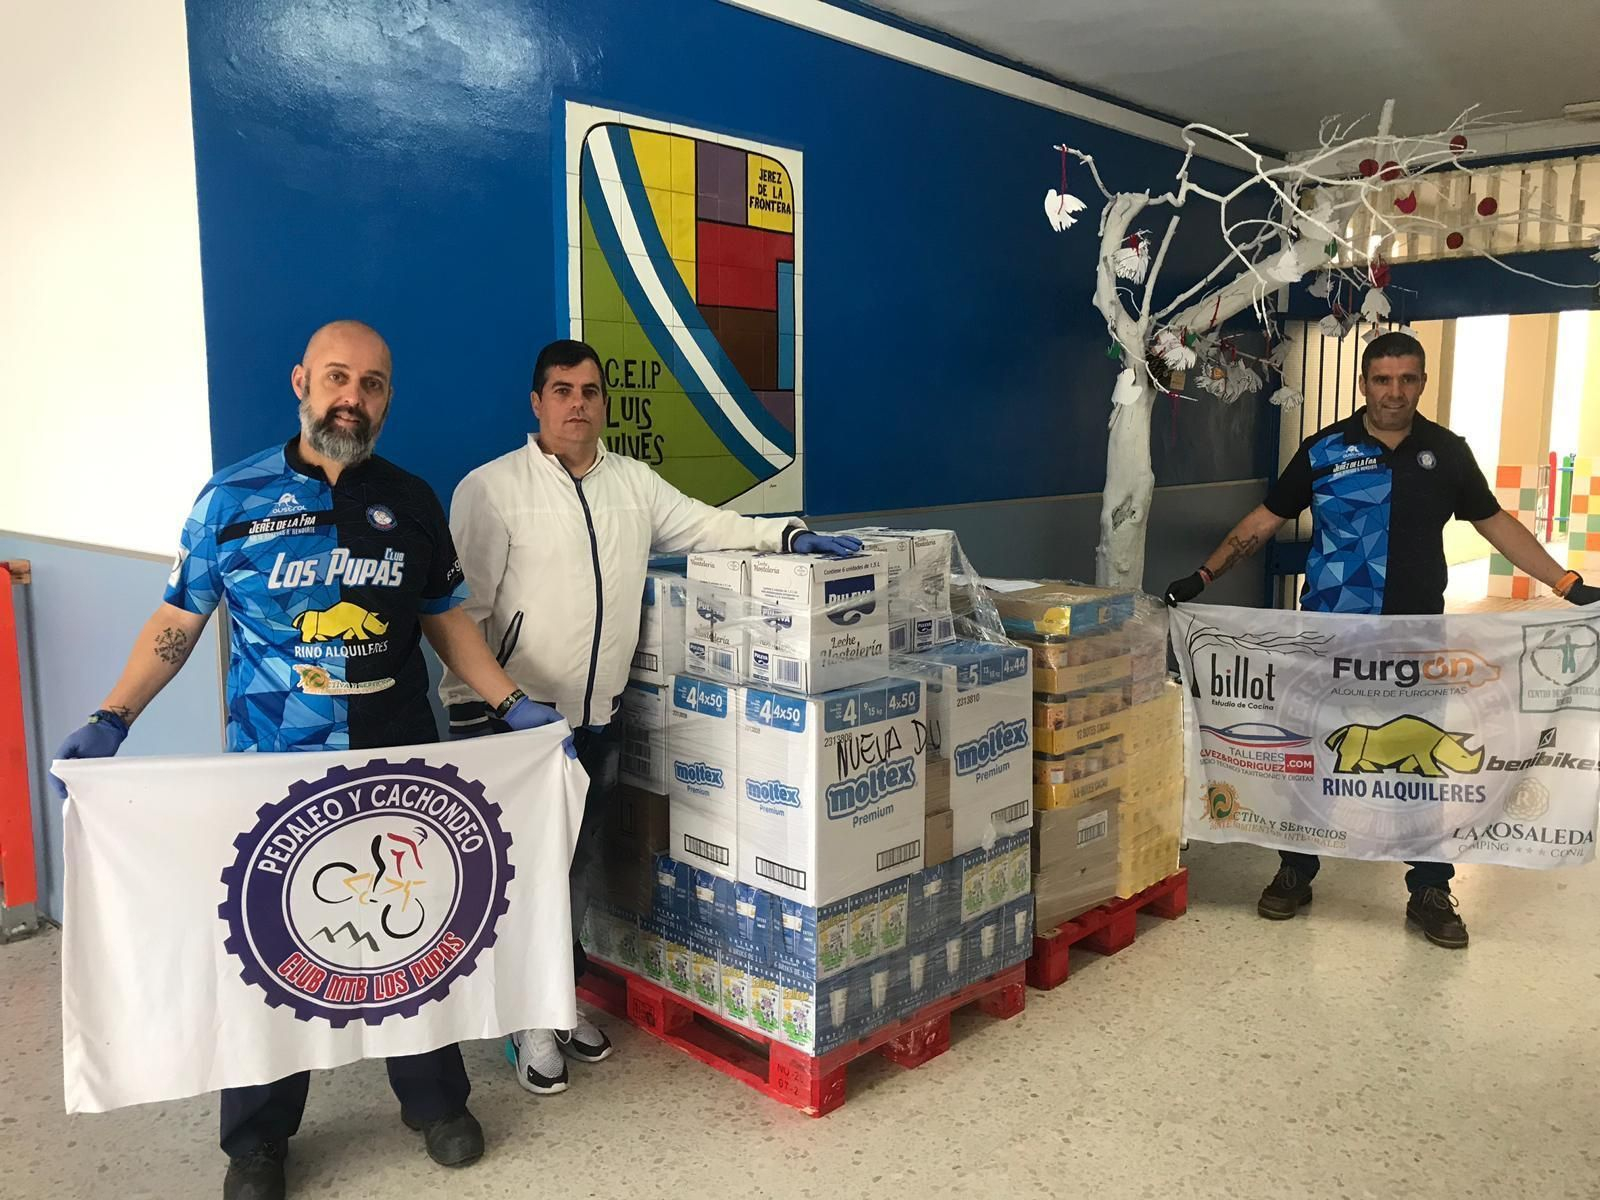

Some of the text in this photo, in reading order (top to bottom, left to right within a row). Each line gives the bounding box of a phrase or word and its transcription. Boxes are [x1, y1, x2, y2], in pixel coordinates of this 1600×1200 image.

[759, 168, 782, 184] JEREZ
[757, 183, 783, 200] DE LA
[749, 196, 791, 215] FRONTERA
[605, 358, 661, 389] C.E.I.P
[606, 396, 652, 430] LUIS
[606, 432, 665, 466] VIVES
[276, 519, 287, 531] DE
[287, 517, 299, 528] LA
[299, 513, 316, 527] FRA
[384, 547, 405, 562] CLUB
[267, 552, 319, 590] LOS
[324, 547, 404, 589] PUPAS
[294, 645, 322, 658] RINO
[831, 633, 857, 649] Leche
[969, 664, 979, 686] 5
[1004, 656, 1026, 673] 4x44
[1210, 653, 1276, 701] billot
[686, 686, 697, 709] 4
[698, 690, 723, 708] 4x50
[1330, 686, 1468, 698] ALQUILER DE FURGONETAS
[760, 700, 771, 723] 4
[773, 705, 801, 722] 4x50
[842, 698, 857, 726] 4
[888, 691, 916, 710] 4x50
[1211, 698, 1236, 709] Estudio
[1247, 702, 1274, 711] Cocina
[837, 726, 902, 780] NUEVA
[954, 718, 1029, 776] moltex
[1228, 747, 1284, 762] TALLERES
[675, 761, 723, 787] moltex
[975, 762, 1010, 783] Premium
[1286, 759, 1313, 769] .COM
[687, 785, 710, 797] Premium
[746, 779, 800, 807] moltex
[825, 756, 916, 820] moltex
[1322, 778, 1486, 803] RINO ALQUILERES
[759, 804, 785, 817] Premium
[852, 803, 894, 828] Premium
[257, 783, 484, 875] PEDALEO Y CACHONDEO
[1268, 819, 1277, 829] Y
[1279, 821, 1348, 840] SERVICIOS
[277, 931, 466, 1002] CLUB MTB LOS PUPAS
[781, 976, 813, 990] ENTERA
